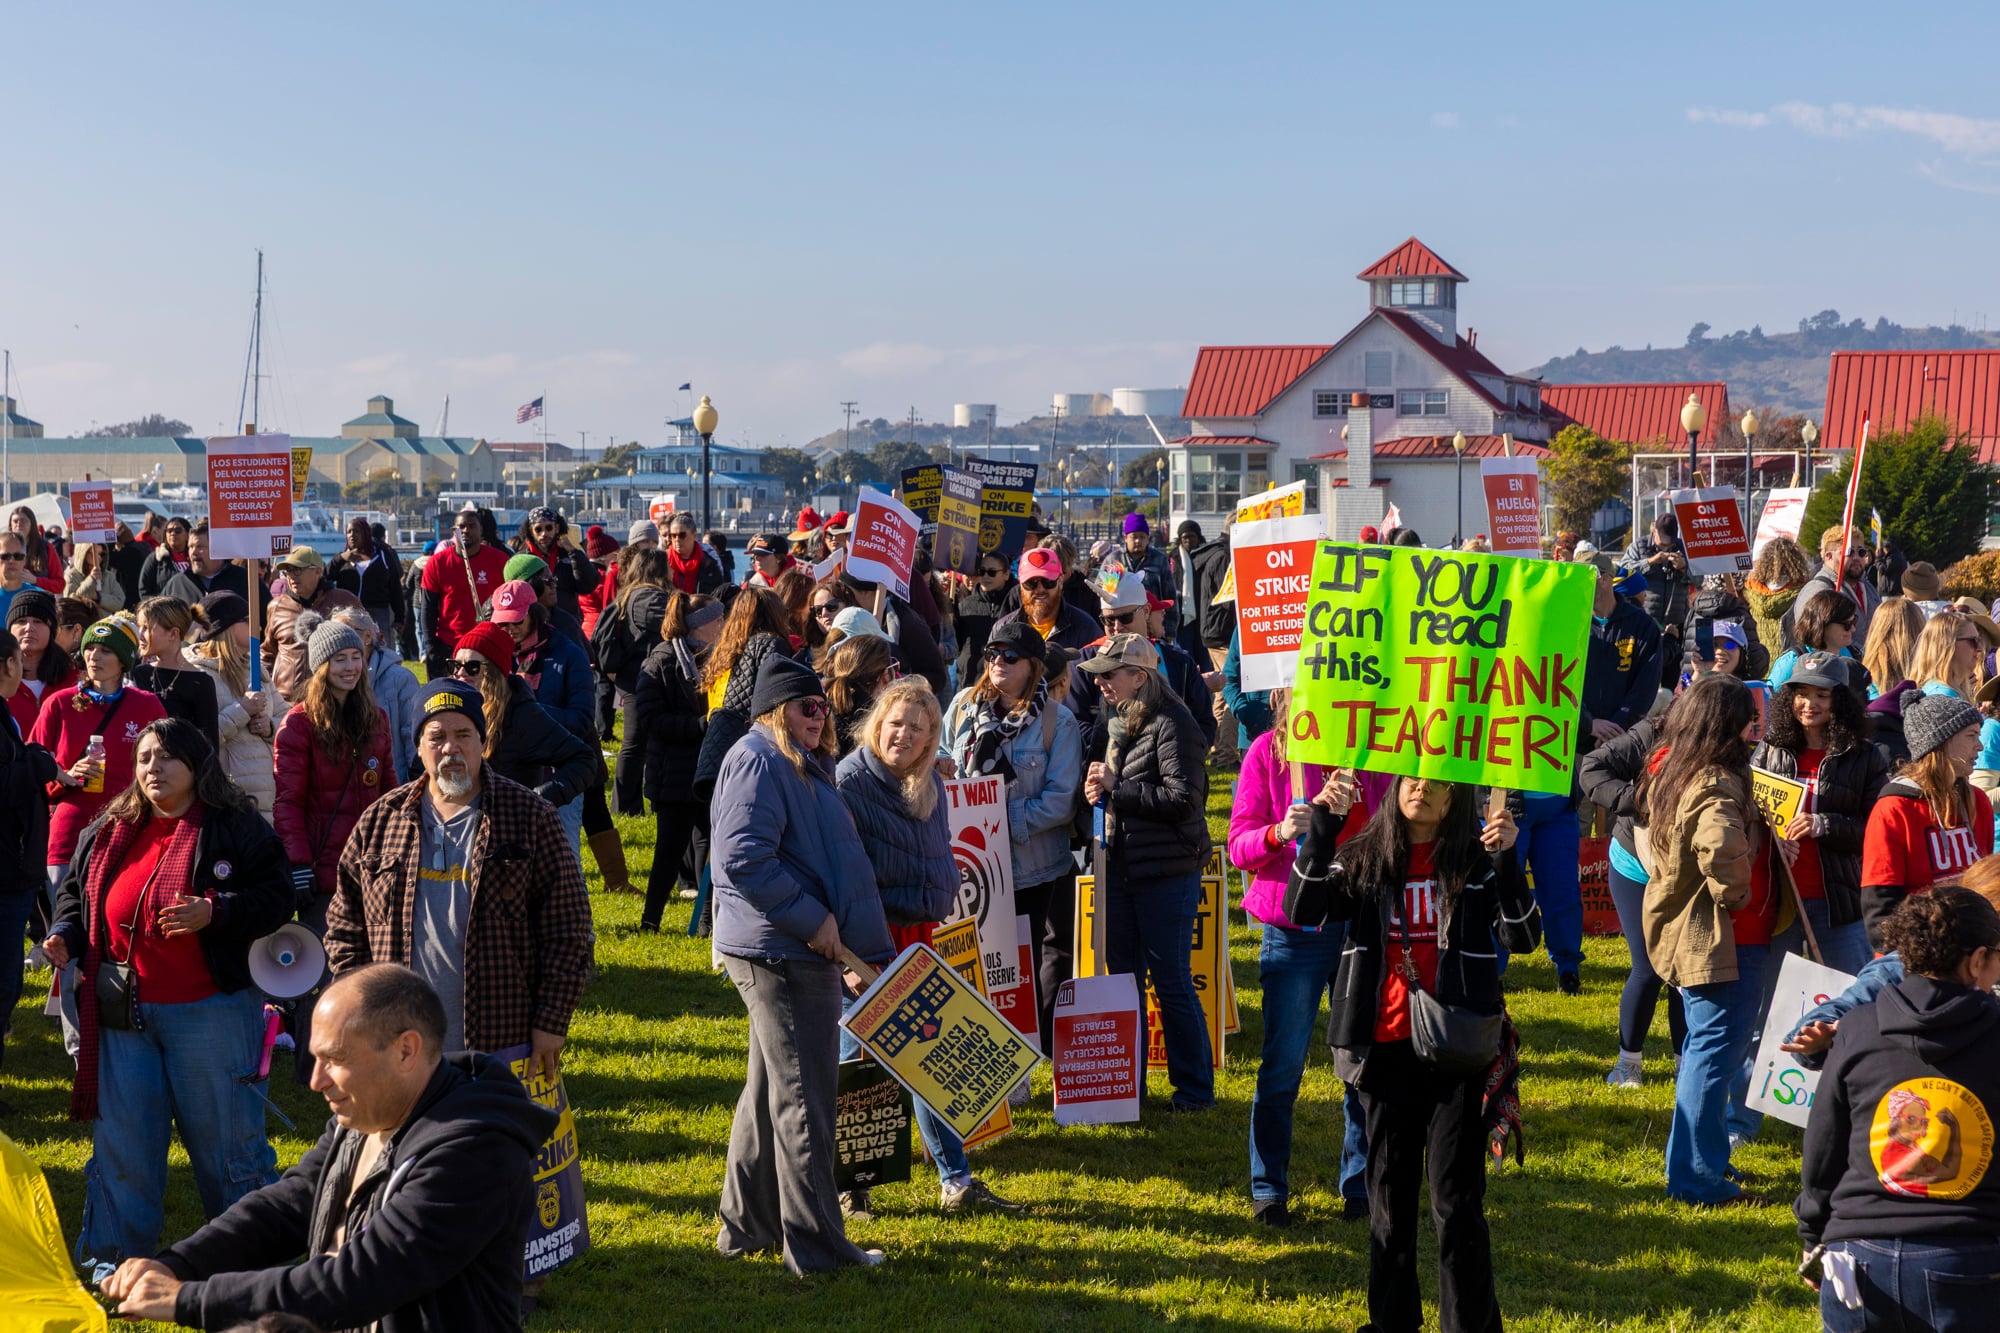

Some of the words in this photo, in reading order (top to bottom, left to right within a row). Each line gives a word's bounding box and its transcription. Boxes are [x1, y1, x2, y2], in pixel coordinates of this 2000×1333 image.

[212, 459, 230, 469] ¡LOS
[232, 458, 288, 466] ESTUDIANTES
[968, 462, 1034, 478] TEAMSTERS
[215, 470, 230, 478] DEL
[231, 469, 269, 478] WCCUSD
[270, 468, 284, 476] NO
[944, 470, 982, 490] TEAMSTERS
[214, 480, 247, 489] PUEDEN
[248, 480, 286, 488] ESPERAR
[1004, 476, 1024, 487] 856
[1508, 479, 1523, 491] EN
[85, 492, 98, 500] ON
[220, 492, 238, 500] POR
[240, 490, 282, 499] ESCUELAS
[949, 483, 966, 496] LOCAL
[965, 487, 976, 500] 856
[988, 492, 1005, 500] ON
[80, 502, 106, 510] STRIKE
[228, 502, 266, 510] SEGURAS
[956, 502, 966, 512] ON
[980, 500, 1026, 514] TRIKE
[1496, 497, 1536, 510] HUELGA
[1698, 504, 1716, 514] ON
[230, 512, 272, 521] ESTABLES!
[884, 512, 902, 528] ON
[943, 508, 976, 529] STRIKE
[1692, 516, 1730, 529] STRIKE
[871, 521, 906, 548] STRIKE
[1496, 526, 1512, 534] CON
[1712, 530, 1731, 538] FULLY
[274, 537, 290, 550] UTR
[871, 534, 886, 545] FOR
[888, 542, 903, 557] FULLY
[1687, 540, 1713, 548] STAFFED
[1714, 536, 1745, 546] SCHOOLS
[856, 539, 886, 552] STAFFED
[887, 550, 910, 574] SCHOOLS
[1266, 550, 1294, 569] ON
[1737, 556, 1750, 567] UTR
[1254, 574, 1310, 597] STRIKE
[1319, 546, 1392, 594] IF
[1410, 554, 1500, 610] YOU
[896, 582, 907, 597] UTR
[1242, 606, 1261, 618] FOR
[1262, 604, 1280, 616] THE
[1282, 602, 1308, 615] SCHO
[1251, 620, 1272, 632] OUR
[1274, 618, 1305, 630] STUDE
[1410, 599, 1512, 648] read
[1266, 632, 1302, 646] DESERV
[1304, 642, 1391, 690] this,
[1405, 653, 1580, 709] THANK
[424, 692, 463, 712] TEAMSTERS
[1292, 710, 1320, 740] a
[1332, 700, 1570, 772] TEACHER!
[963, 780, 998, 807] WAIT
[1770, 787, 1788, 801] NEED
[1930, 827, 1981, 870] UTR
[964, 930, 976, 950] NO
[914, 954, 933, 970] NO
[884, 964, 923, 1004] PODEMOS
[988, 966, 1016, 987] ESERVE
[1059, 988, 1073, 1005] UTR
[854, 998, 890, 1034] ESPERAR
[962, 1016, 976, 1029] Y
[1073, 1020, 1116, 1033] ESTABLES!
[1071, 1035, 1077, 1046] Y
[1078, 1033, 1118, 1045] SEGURAS
[917, 1023, 968, 1076] ESTABLE
[933, 1024, 990, 1084] COMPLETO
[1064, 1047, 1105, 1059] ESCUELAS
[1107, 1045, 1125, 1055] POR
[944, 1038, 1000, 1096] PERSONAL
[967, 1037, 1022, 1096] ESCUELAS
[1059, 1061, 1096, 1072] ESPERAR
[1098, 1058, 1130, 1070] PUEDEN
[1061, 1076, 1074, 1086] NO
[1076, 1074, 1112, 1084] WCCUSD
[1114, 1071, 1129, 1080] DEL
[967, 1060, 1021, 1118] NECESITAMOS
[1058, 1085, 1111, 1099] ESTUDIANTES
[1114, 1082, 1134, 1094] ¡LOS
[1922, 1081, 1934, 1090] WE
[1936, 1081, 1960, 1095] CAN'T
[854, 1089, 900, 1114] Students
[944, 1092, 972, 1122] CON
[1960, 1090, 1978, 1110] WAIT
[872, 1104, 902, 1120] FOR
[1974, 1107, 1986, 1122] FOR
[1981, 1122, 1992, 1142] SAFE
[839, 1132, 896, 1152] STABLE
[535, 1130, 576, 1176] RIKE
[841, 1152, 851, 1164] &
[855, 1145, 894, 1162] SAFE
[1969, 1158, 1988, 1182] STABLE
[524, 1218, 580, 1260] EAMSTERS
[529, 1250, 560, 1275] LOCAL
[558, 1242, 574, 1262] 856
